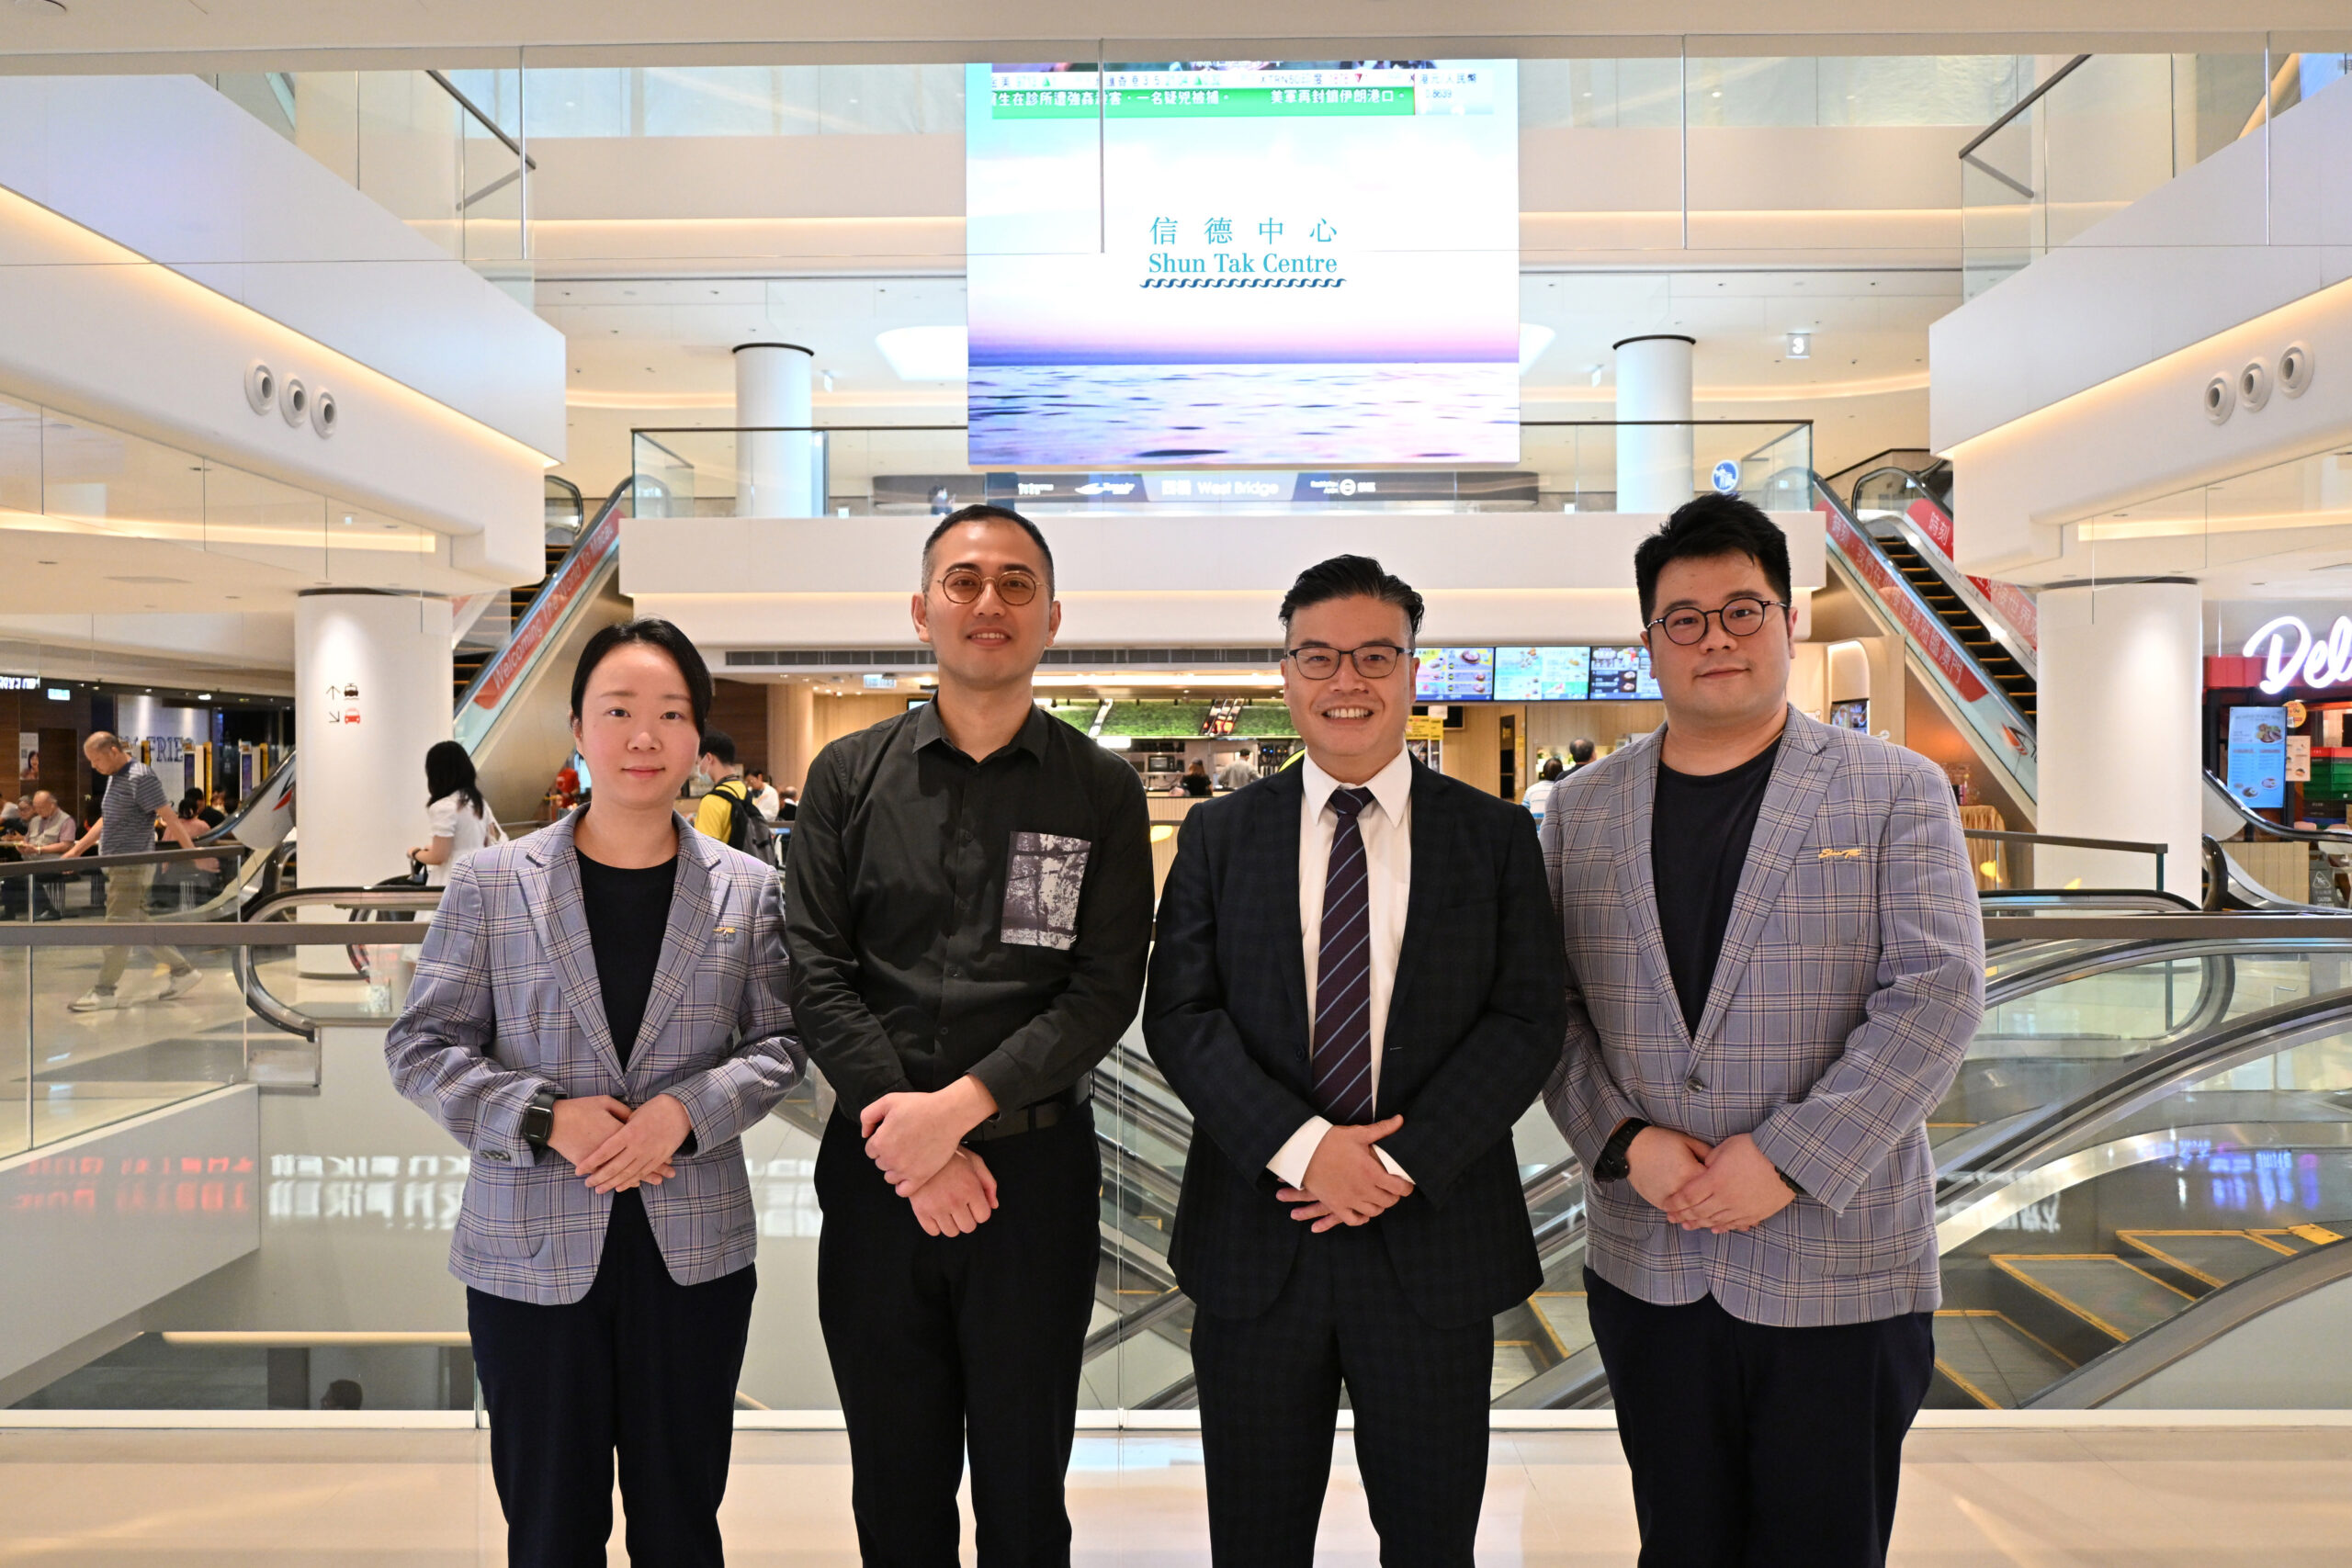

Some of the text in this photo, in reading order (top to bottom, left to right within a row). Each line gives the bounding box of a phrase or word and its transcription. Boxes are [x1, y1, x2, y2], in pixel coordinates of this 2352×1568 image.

[1149, 217, 1337, 245] 信德中心
[1148, 253, 1337, 273] Shun Tak Centre
[1792, 337, 1804, 355] 3
[1197, 480, 1279, 497] West Bridge
[492, 617, 543, 690] Welcoming
[541, 596, 560, 623] The
[558, 561, 582, 598] World
[580, 551, 592, 570] To
[2243, 615, 2352, 694] Del
